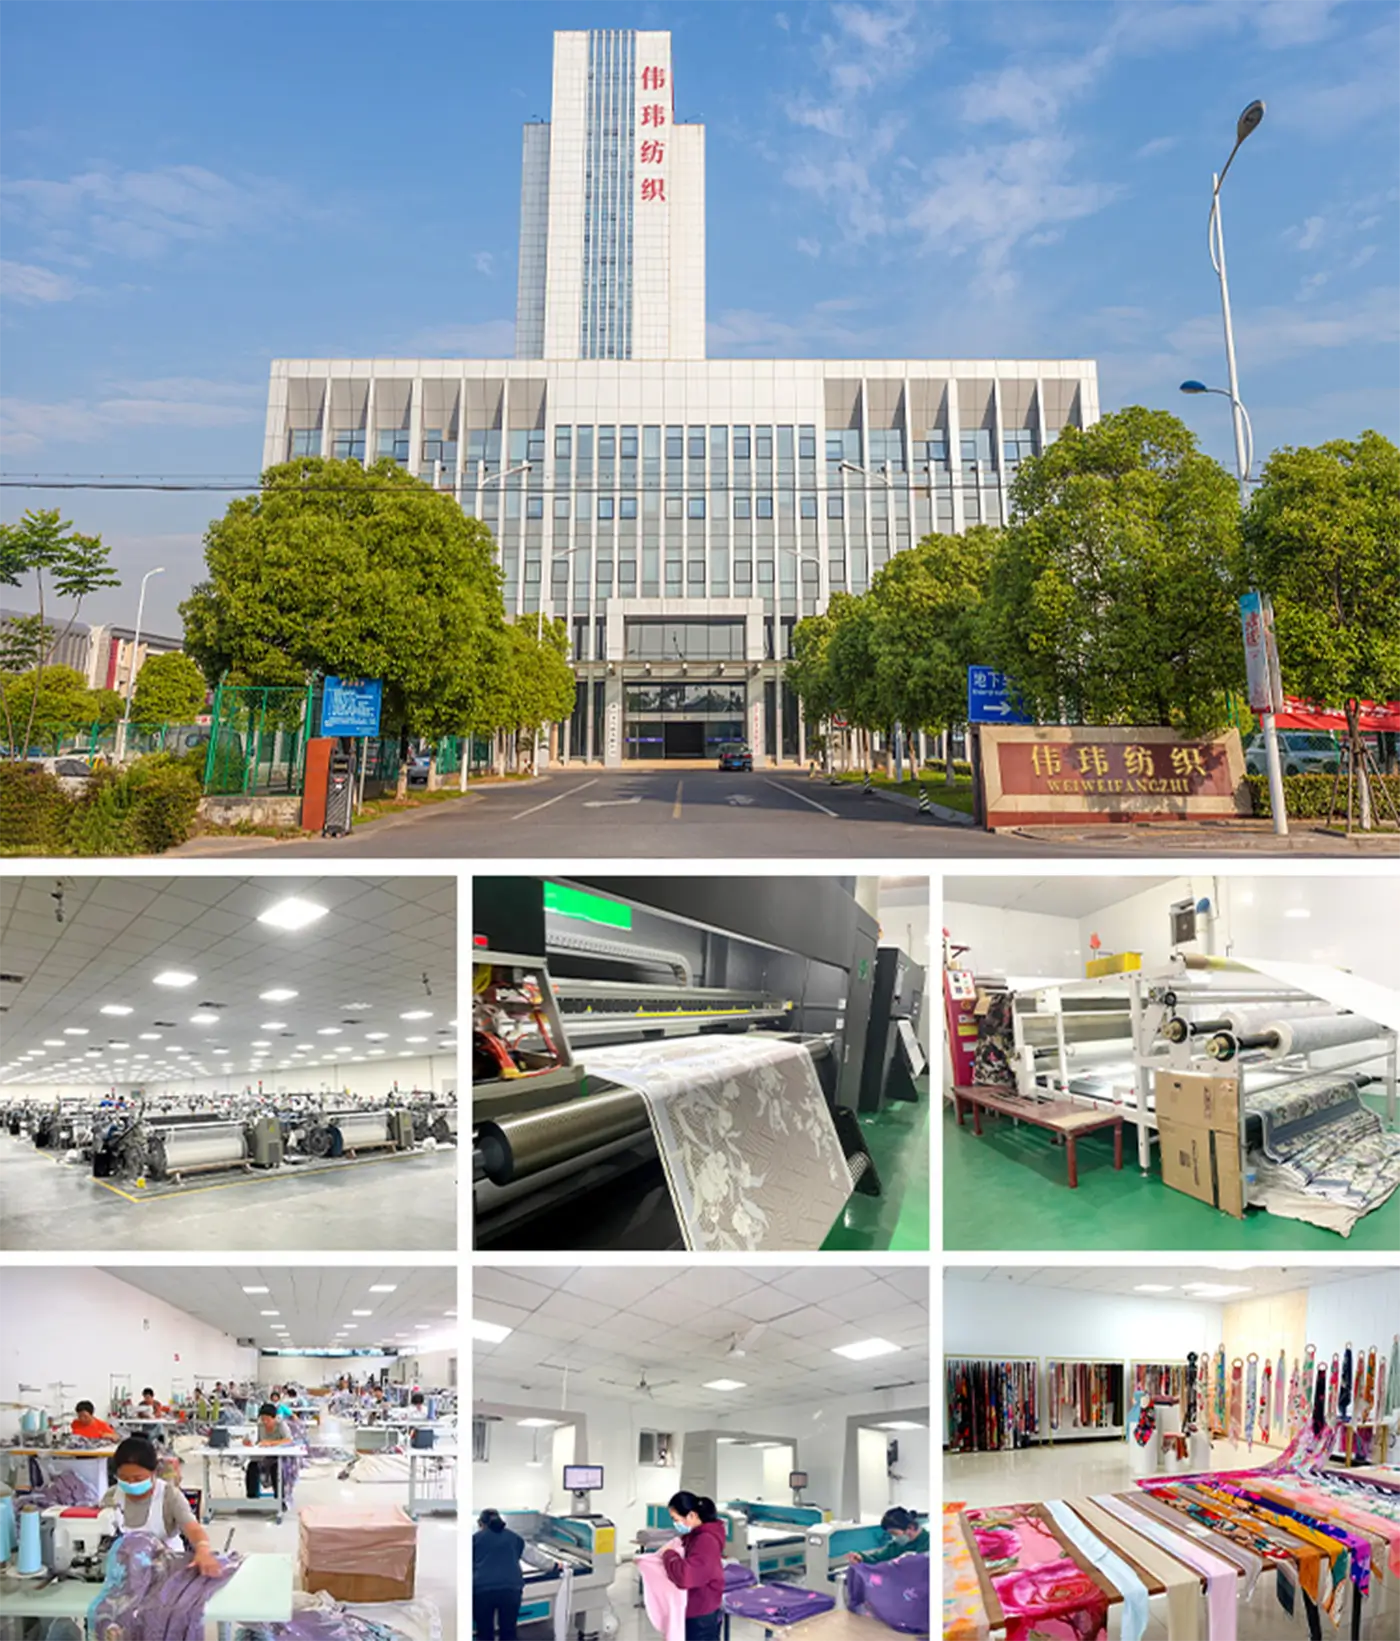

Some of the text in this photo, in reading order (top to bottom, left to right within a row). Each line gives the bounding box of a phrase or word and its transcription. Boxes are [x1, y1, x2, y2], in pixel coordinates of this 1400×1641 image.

[641, 66, 665, 202] 伟玮纺织
[1032, 744, 1206, 777] 伟玮纺织
